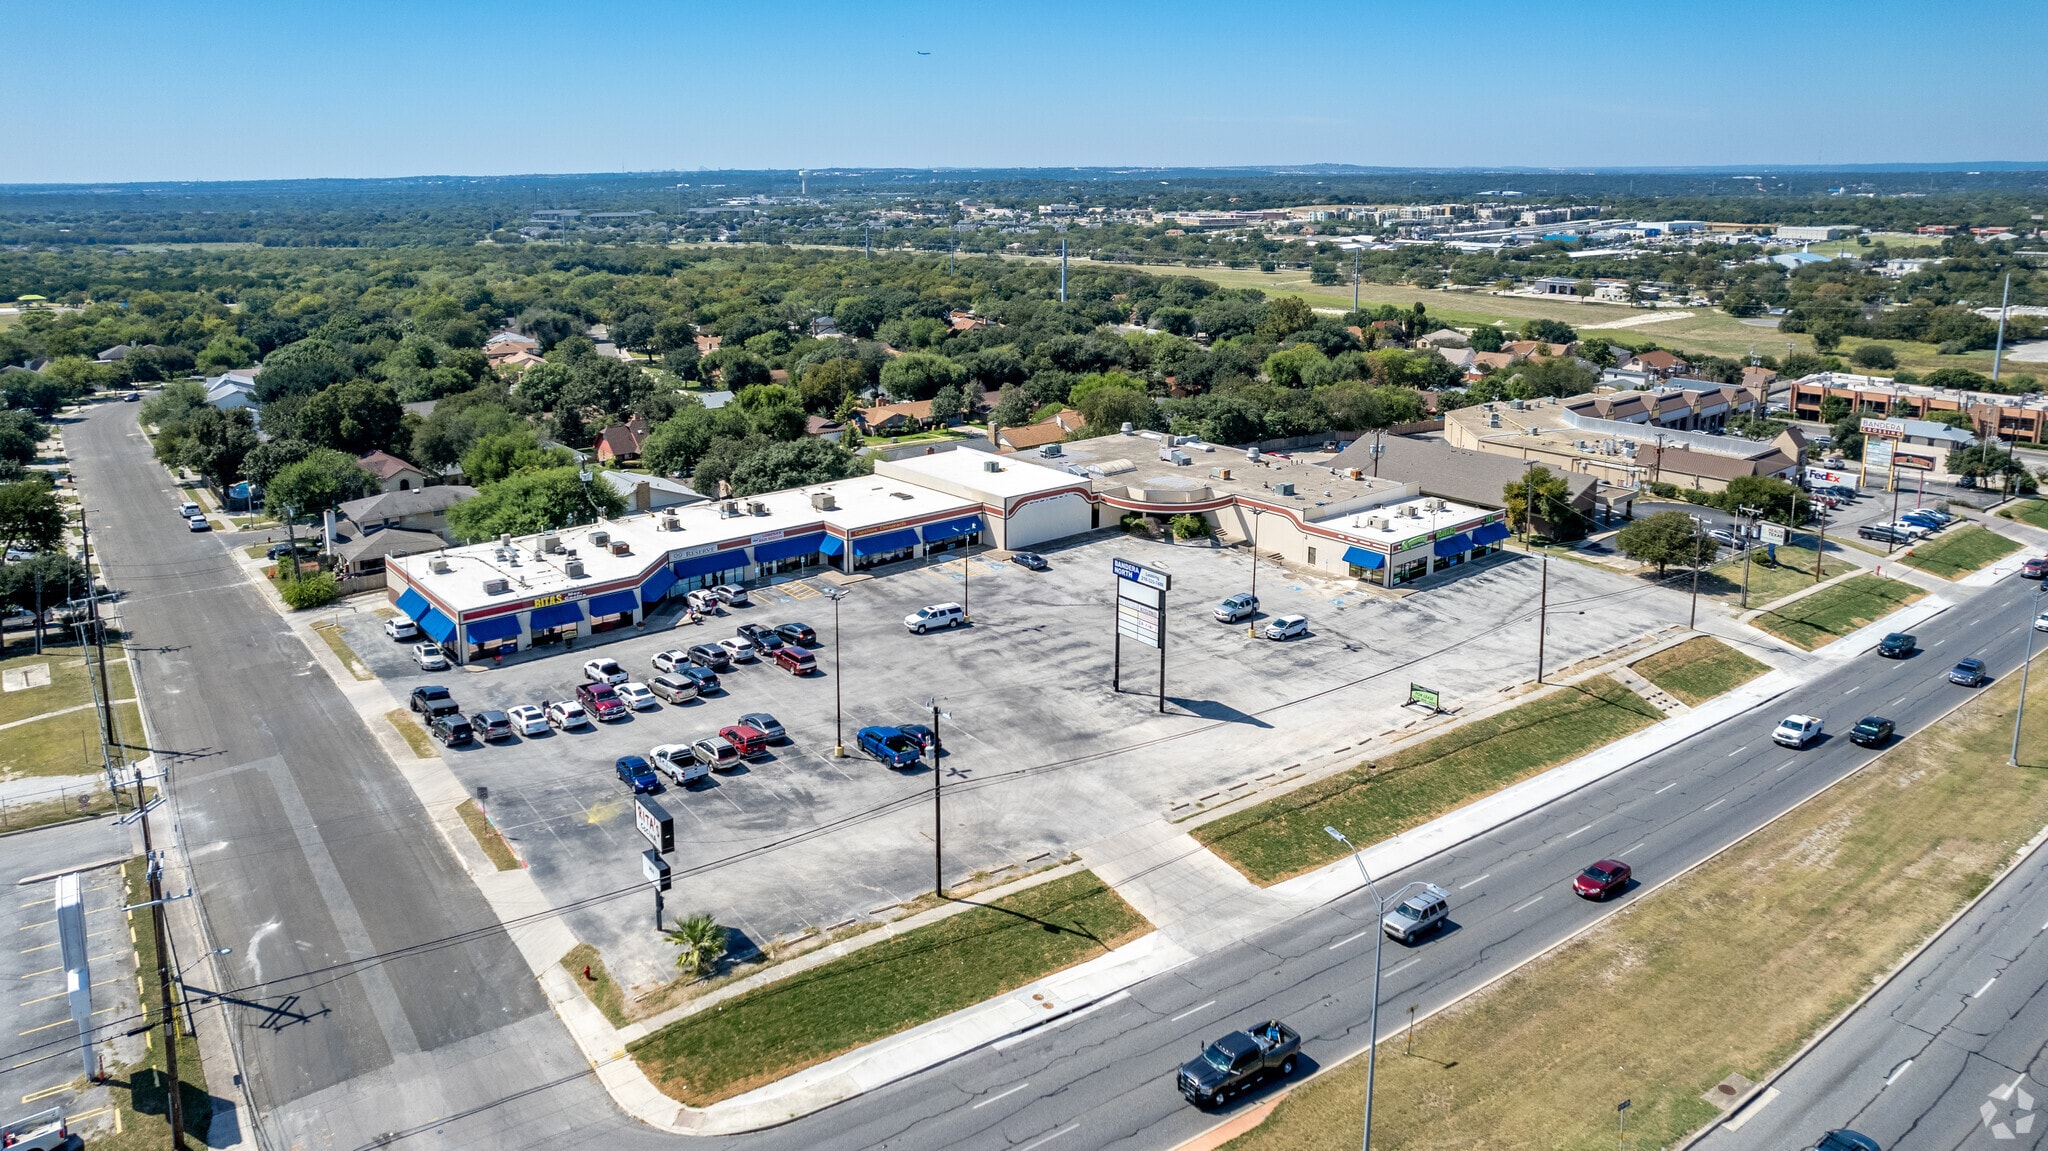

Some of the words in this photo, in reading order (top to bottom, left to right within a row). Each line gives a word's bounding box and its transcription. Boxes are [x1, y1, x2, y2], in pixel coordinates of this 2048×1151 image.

[1863, 420, 1901, 430] BANDERA
[1809, 469, 1840, 483] FedEx
[1114, 560, 1140, 574] BANDERA
[1114, 567, 1133, 579] NORTH
